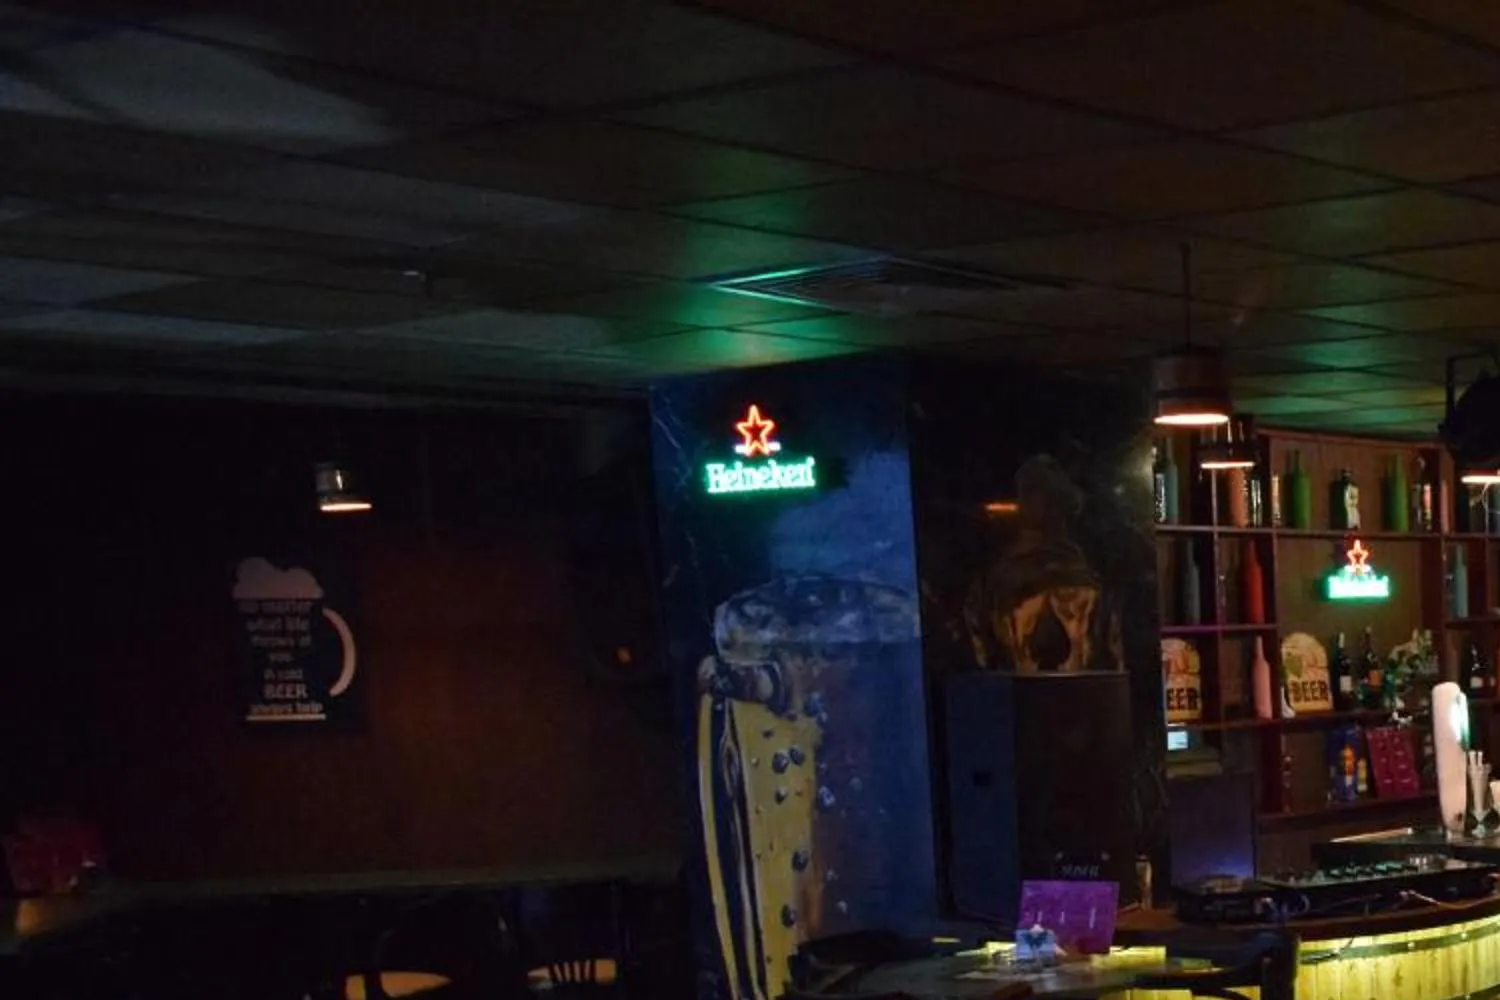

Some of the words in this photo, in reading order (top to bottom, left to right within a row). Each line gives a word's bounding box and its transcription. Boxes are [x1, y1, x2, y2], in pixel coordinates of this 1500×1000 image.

[705, 457, 815, 493] Heineken
[264, 683, 308, 699] BEER
[1166, 688, 1198, 710] EER
[1290, 680, 1329, 703] BEER
